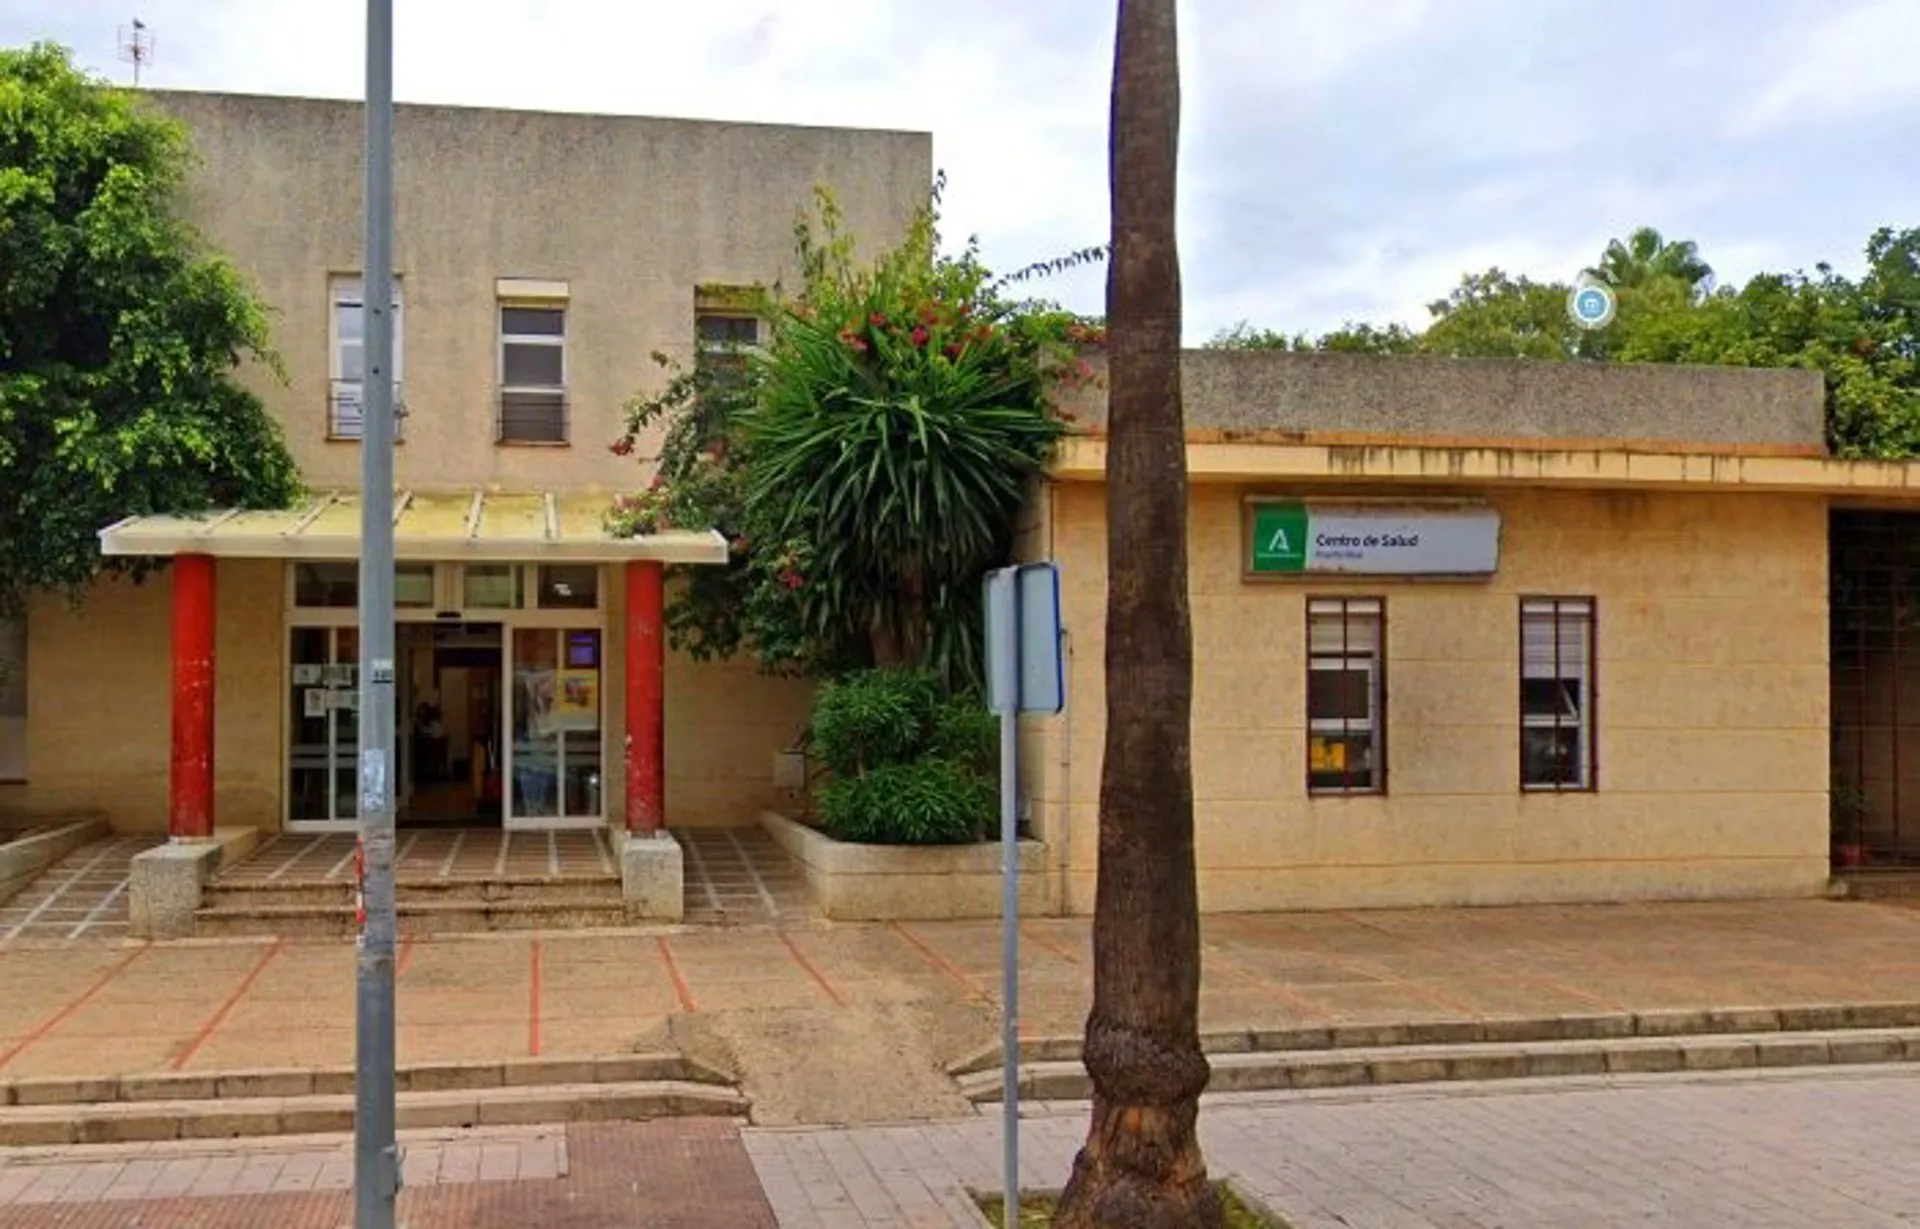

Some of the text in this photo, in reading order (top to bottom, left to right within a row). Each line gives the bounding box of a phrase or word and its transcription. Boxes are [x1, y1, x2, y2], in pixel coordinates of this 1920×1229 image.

[1316, 533, 1418, 547] Centro de Salud
